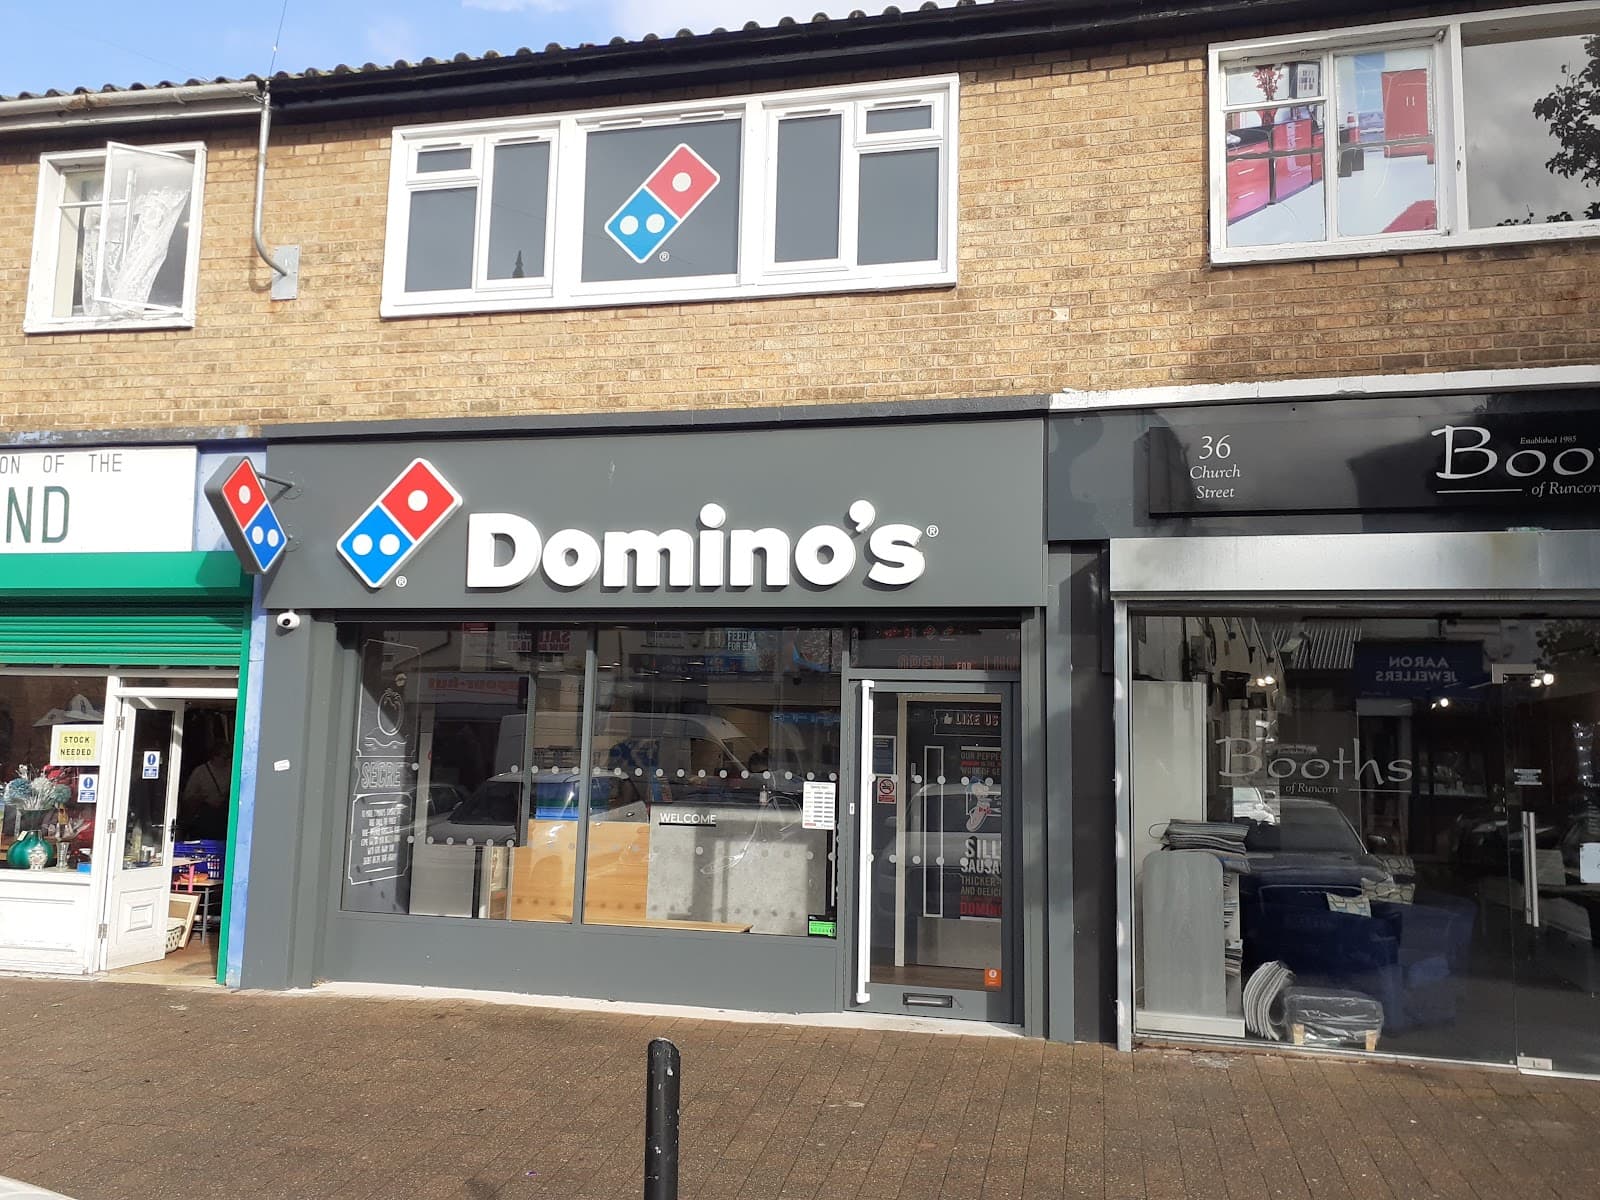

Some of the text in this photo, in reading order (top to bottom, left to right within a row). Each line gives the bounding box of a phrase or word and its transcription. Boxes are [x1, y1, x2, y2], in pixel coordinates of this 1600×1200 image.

[1199, 434, 1231, 460] 36
[1519, 437, 1557, 445] Established
[1431, 425, 1600, 479] Boo
[43, 454, 65, 474] OF
[89, 453, 123, 473] THE
[1190, 464, 1241, 480] Church
[1196, 485, 1235, 499] Street
[1531, 481, 1546, 497] of
[5, 485, 70, 544] ND
[467, 500, 926, 590] Domino's
[727, 631, 747, 641] FEED
[955, 713, 999, 726] LIKE US
[63, 736, 90, 744] STOCK
[60, 748, 92, 756] NEEDED
[1215, 736, 1413, 785] Booths
[1285, 782, 1339, 794] of Runcorn
[659, 812, 717, 824] WELCOME
[961, 887, 975, 896] AND
